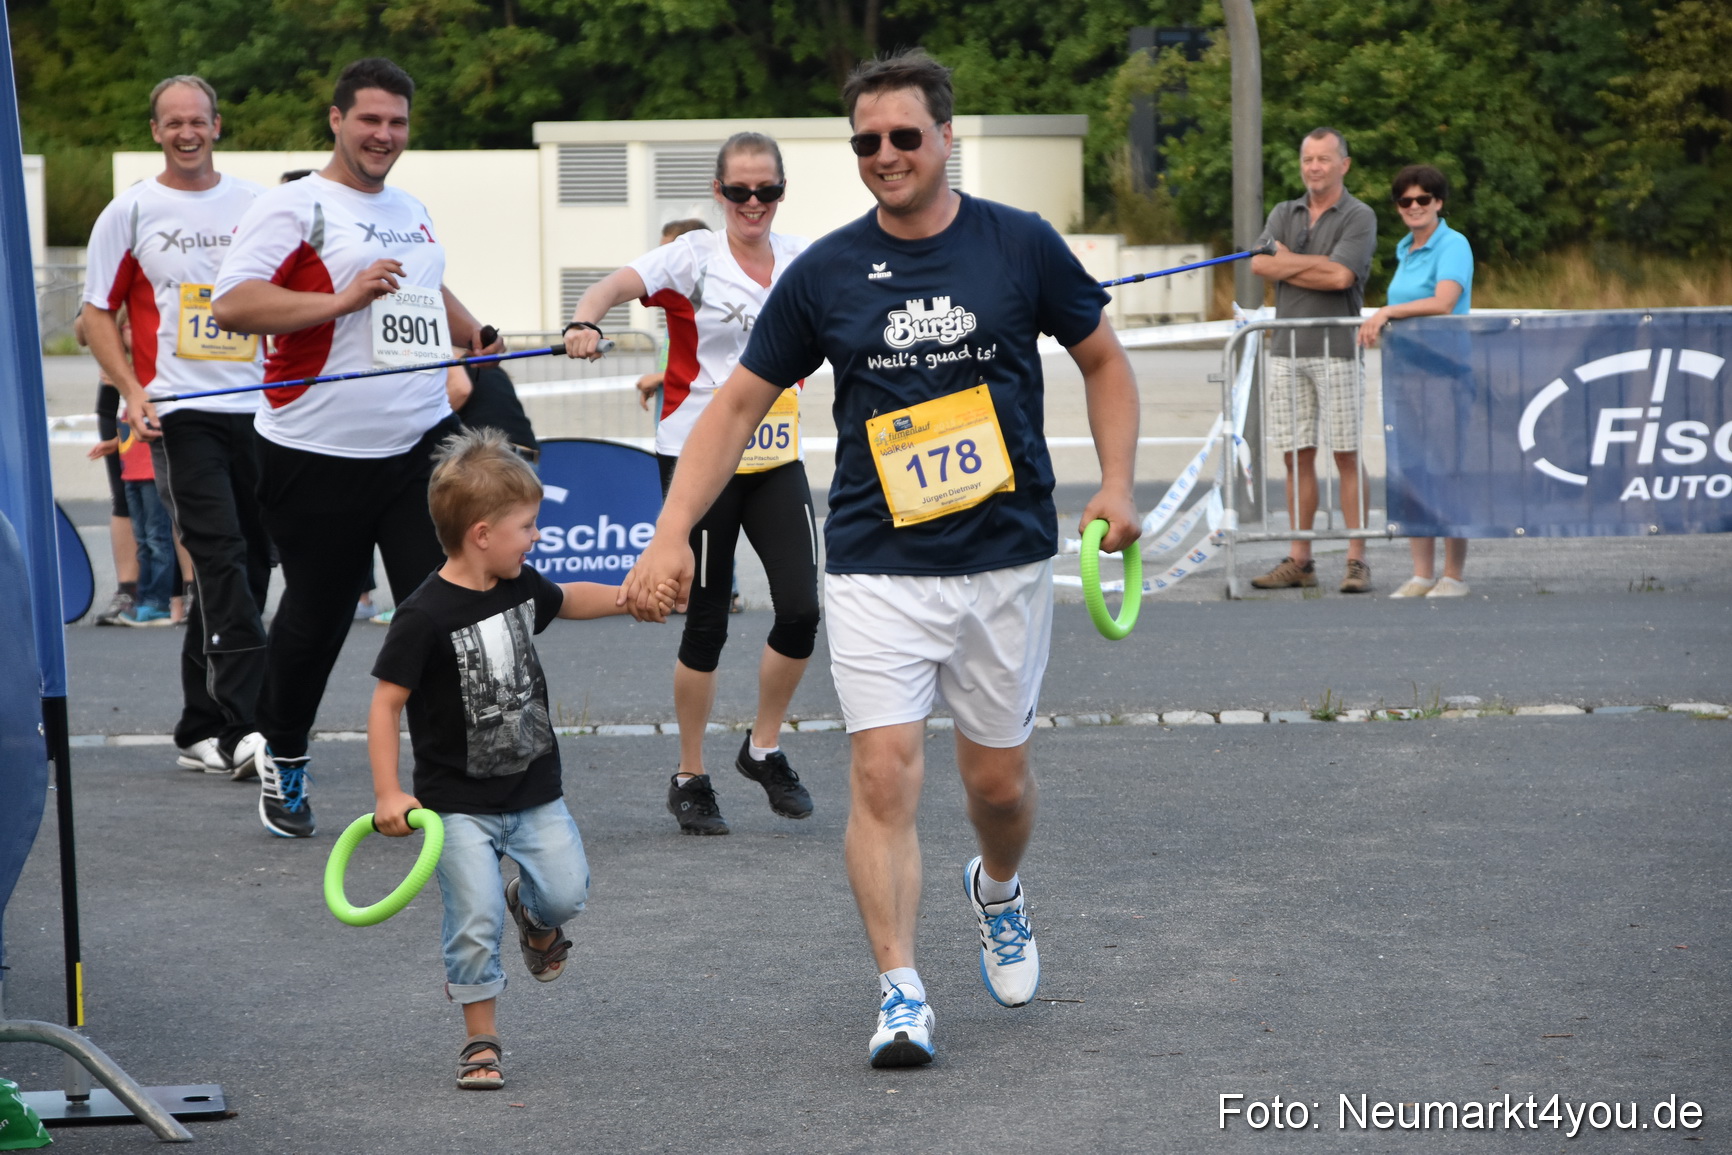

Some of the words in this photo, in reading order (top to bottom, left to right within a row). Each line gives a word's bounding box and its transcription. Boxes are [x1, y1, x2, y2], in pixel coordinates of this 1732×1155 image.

[355, 223, 436, 248] Xplus1
[868, 270, 892, 280] erima
[382, 313, 440, 347] 8901
[884, 306, 977, 348] Burgis
[377, 348, 451, 360] www.df-sports.de
[868, 352, 918, 370] Weil's
[925, 344, 973, 369] guad
[977, 343, 997, 361] is!
[889, 421, 932, 441] firmenlauf
[906, 438, 983, 490] 178
[922, 490, 948, 504] Jürgen
[948, 481, 982, 497] Dietmayr
[1620, 474, 1732, 502] AUTO
[525, 553, 641, 574] UTOMOB
